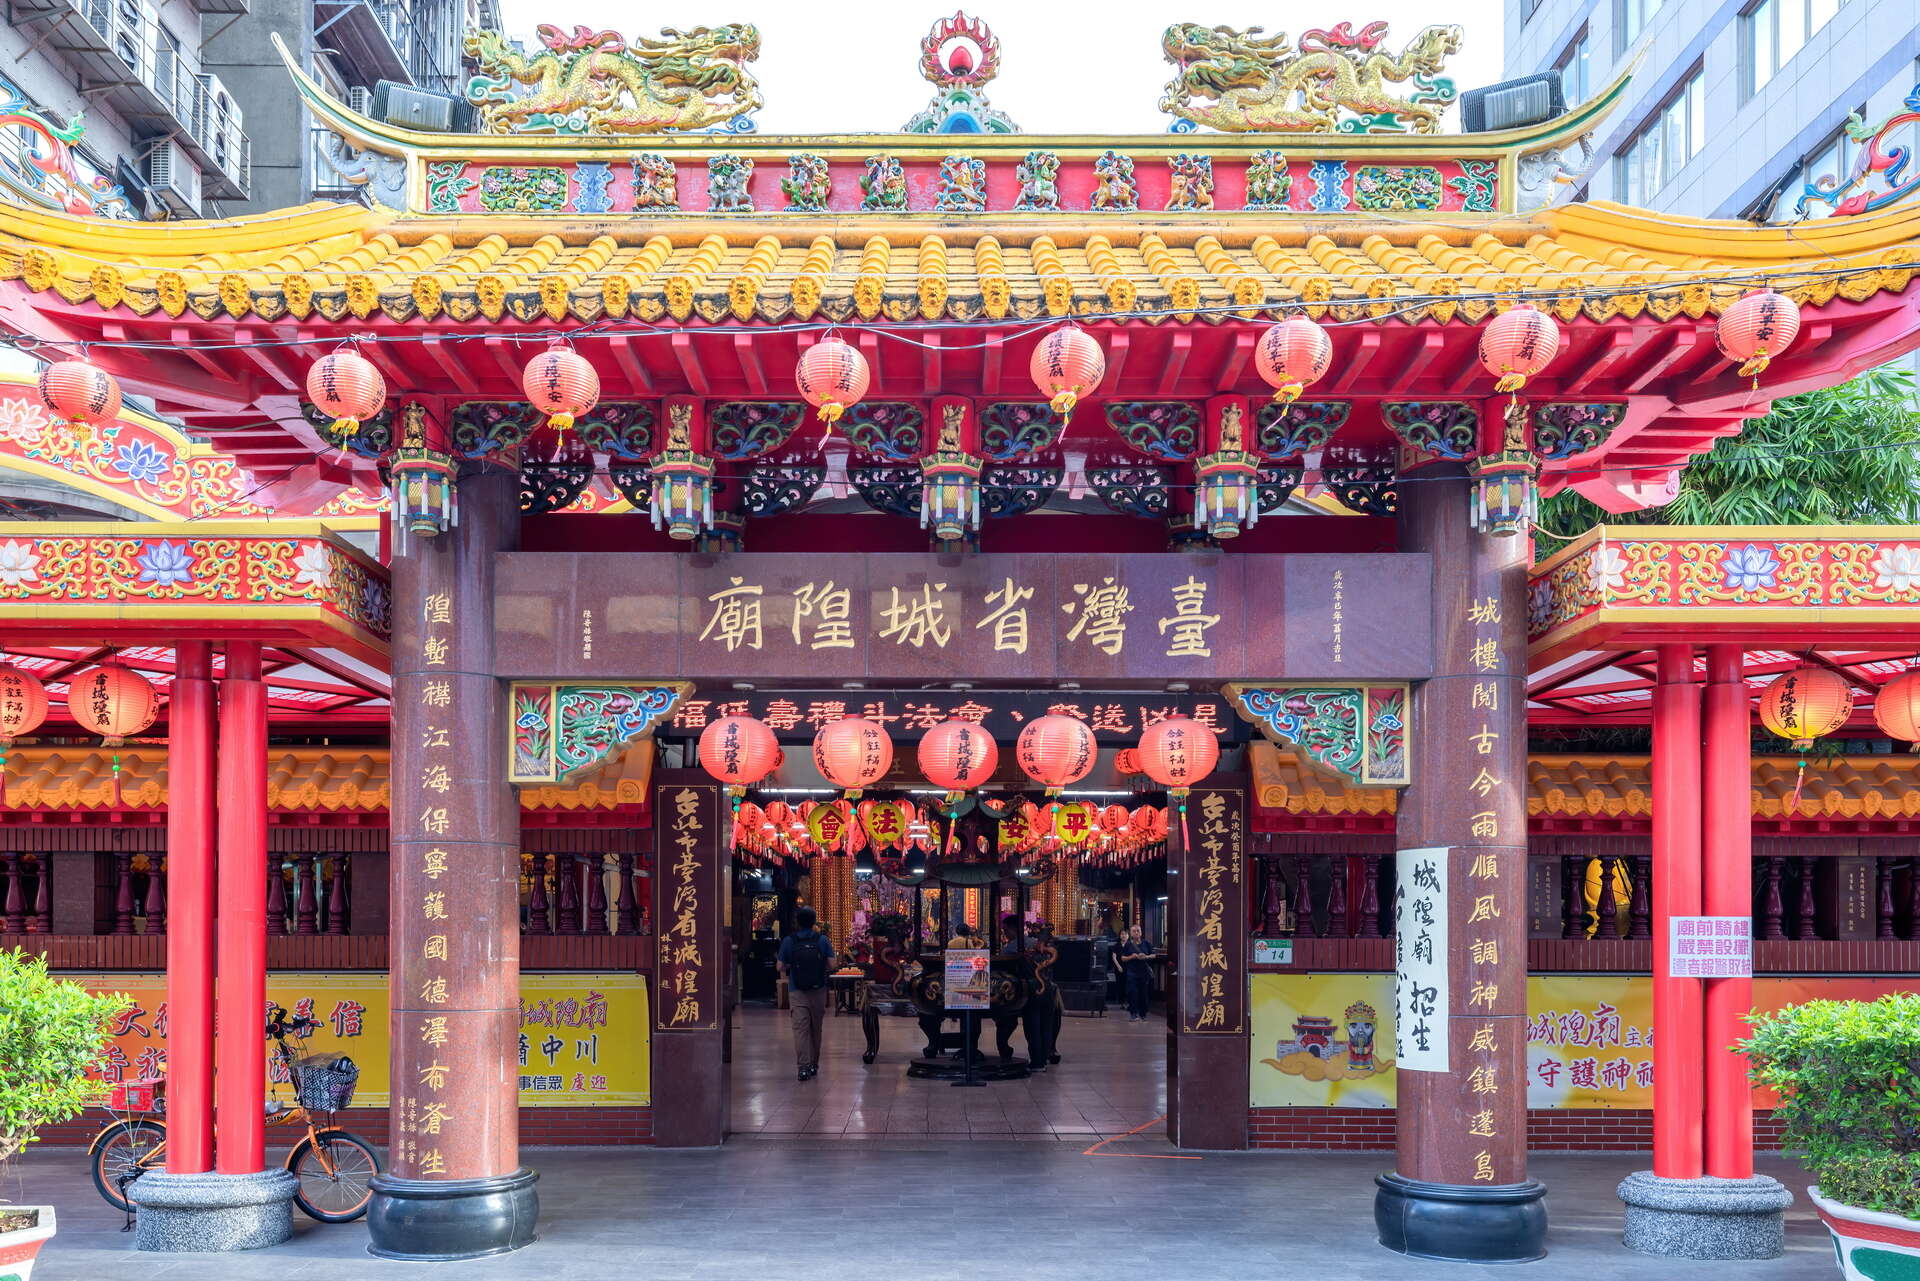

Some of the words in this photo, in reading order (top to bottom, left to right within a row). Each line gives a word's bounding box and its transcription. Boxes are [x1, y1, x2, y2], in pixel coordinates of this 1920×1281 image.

[699, 576, 1221, 656] 臺灣省城隍廟
[818, 809, 845, 841] 會
[872, 808, 899, 835] 法
[1001, 814, 1029, 839] 安
[1063, 813, 1089, 837] 平
[1467, 597, 1501, 1181] 城樓閱古今雨順風調神威鎮蓬島
[1412, 859, 1441, 965] 城隍廟
[1677, 920, 1748, 936] 廟前騎樓
[1272, 950, 1285, 960] 14
[1677, 939, 1748, 955] 嚴禁設攤
[112, 1001, 167, 1038] 大
[1410, 981, 1438, 1051] 招生
[1527, 1003, 1620, 1048] 城隍廟
[1527, 1059, 1653, 1089] 守護神
